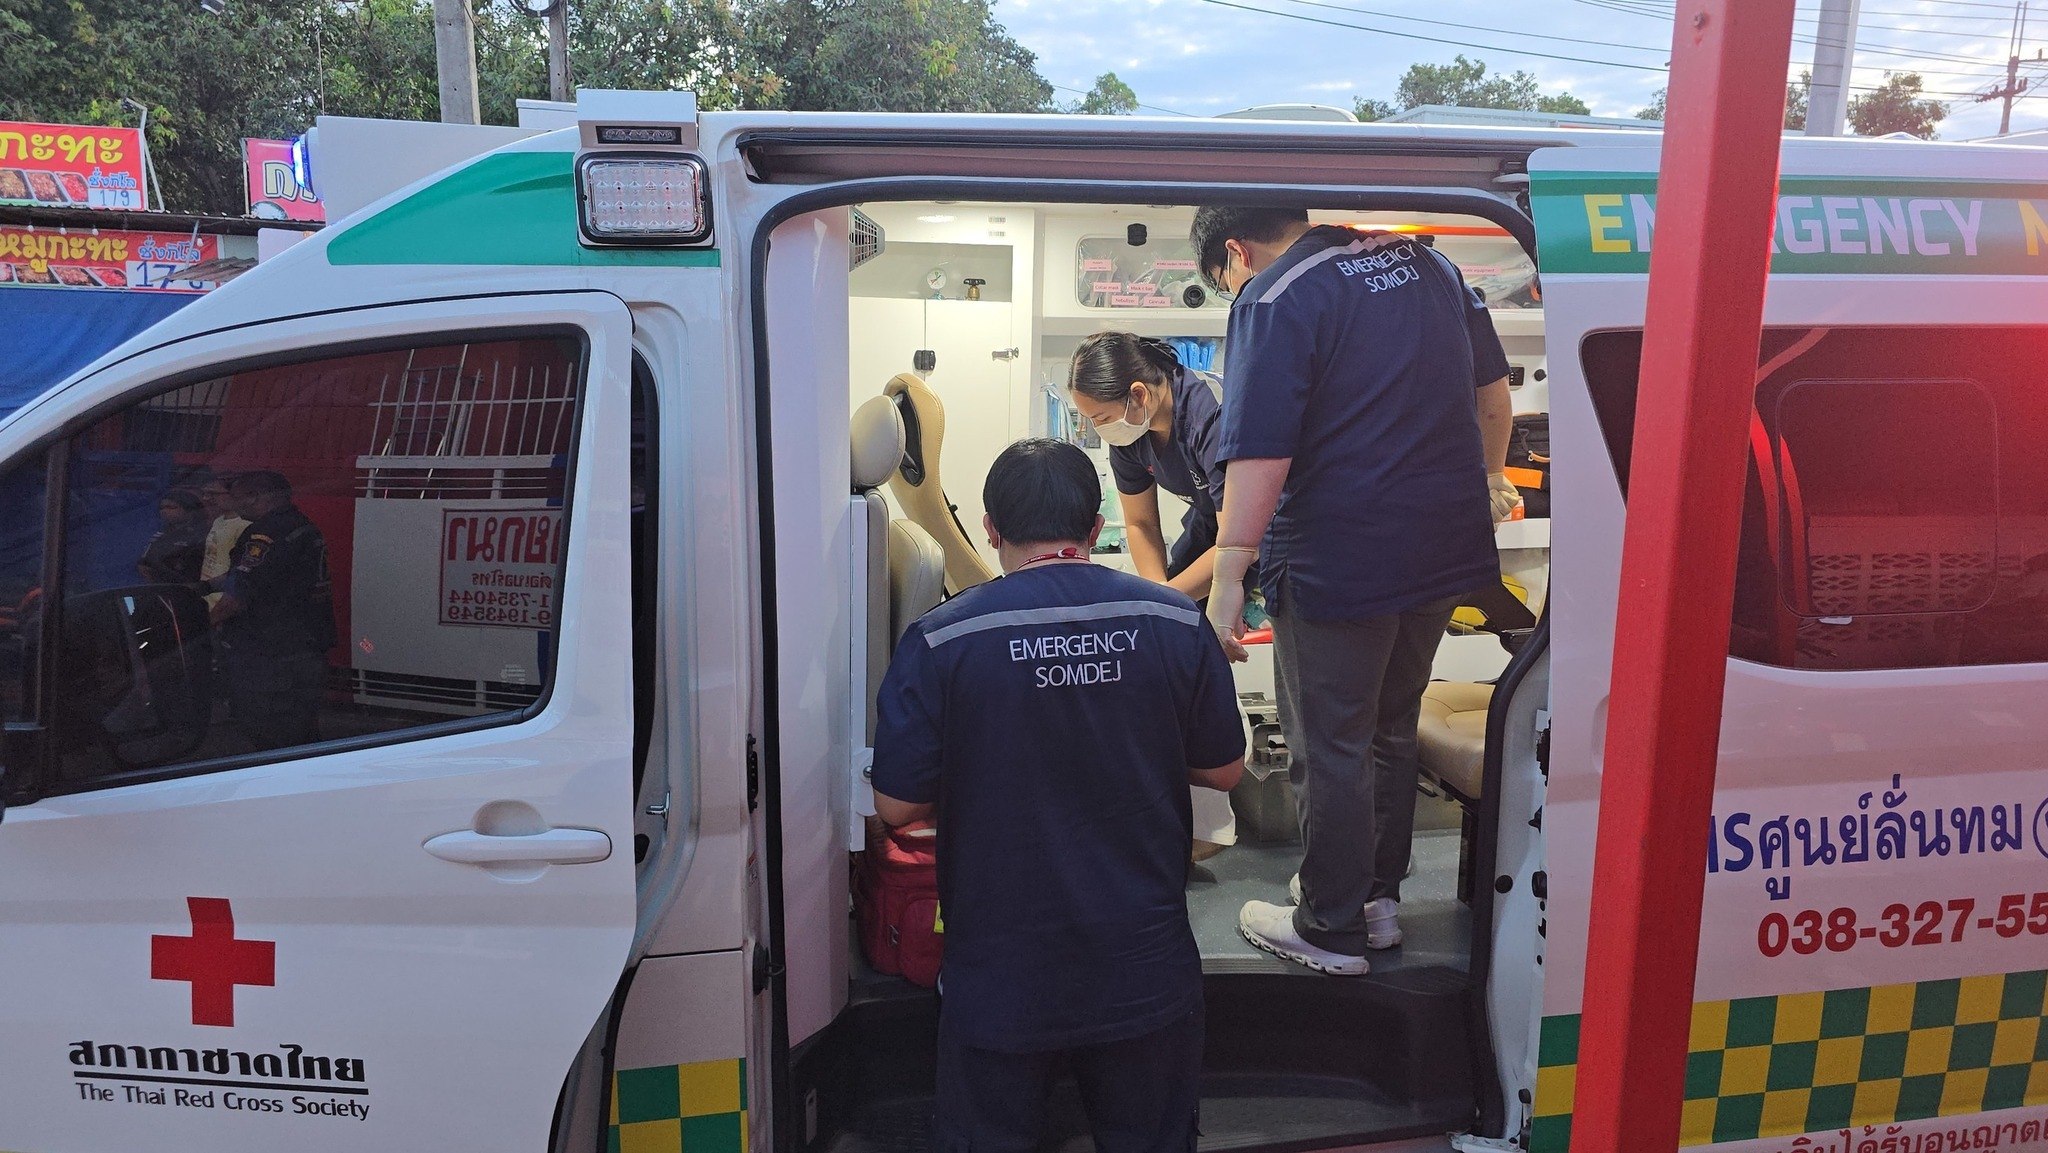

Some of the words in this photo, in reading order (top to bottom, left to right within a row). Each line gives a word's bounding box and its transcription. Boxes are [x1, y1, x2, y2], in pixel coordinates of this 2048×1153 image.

[100, 190, 130, 206] 179
[1009, 629, 1139, 662] EMERGENCY
[1035, 660, 1122, 688] SOMDEJ
[69, 1040, 366, 1082] สภากาชาดไทย
[76, 1082, 114, 1102] The
[121, 1085, 167, 1106] Thai
[174, 1088, 215, 1109] Red
[223, 1092, 284, 1114] Cross
[292, 1096, 370, 1122] Society
